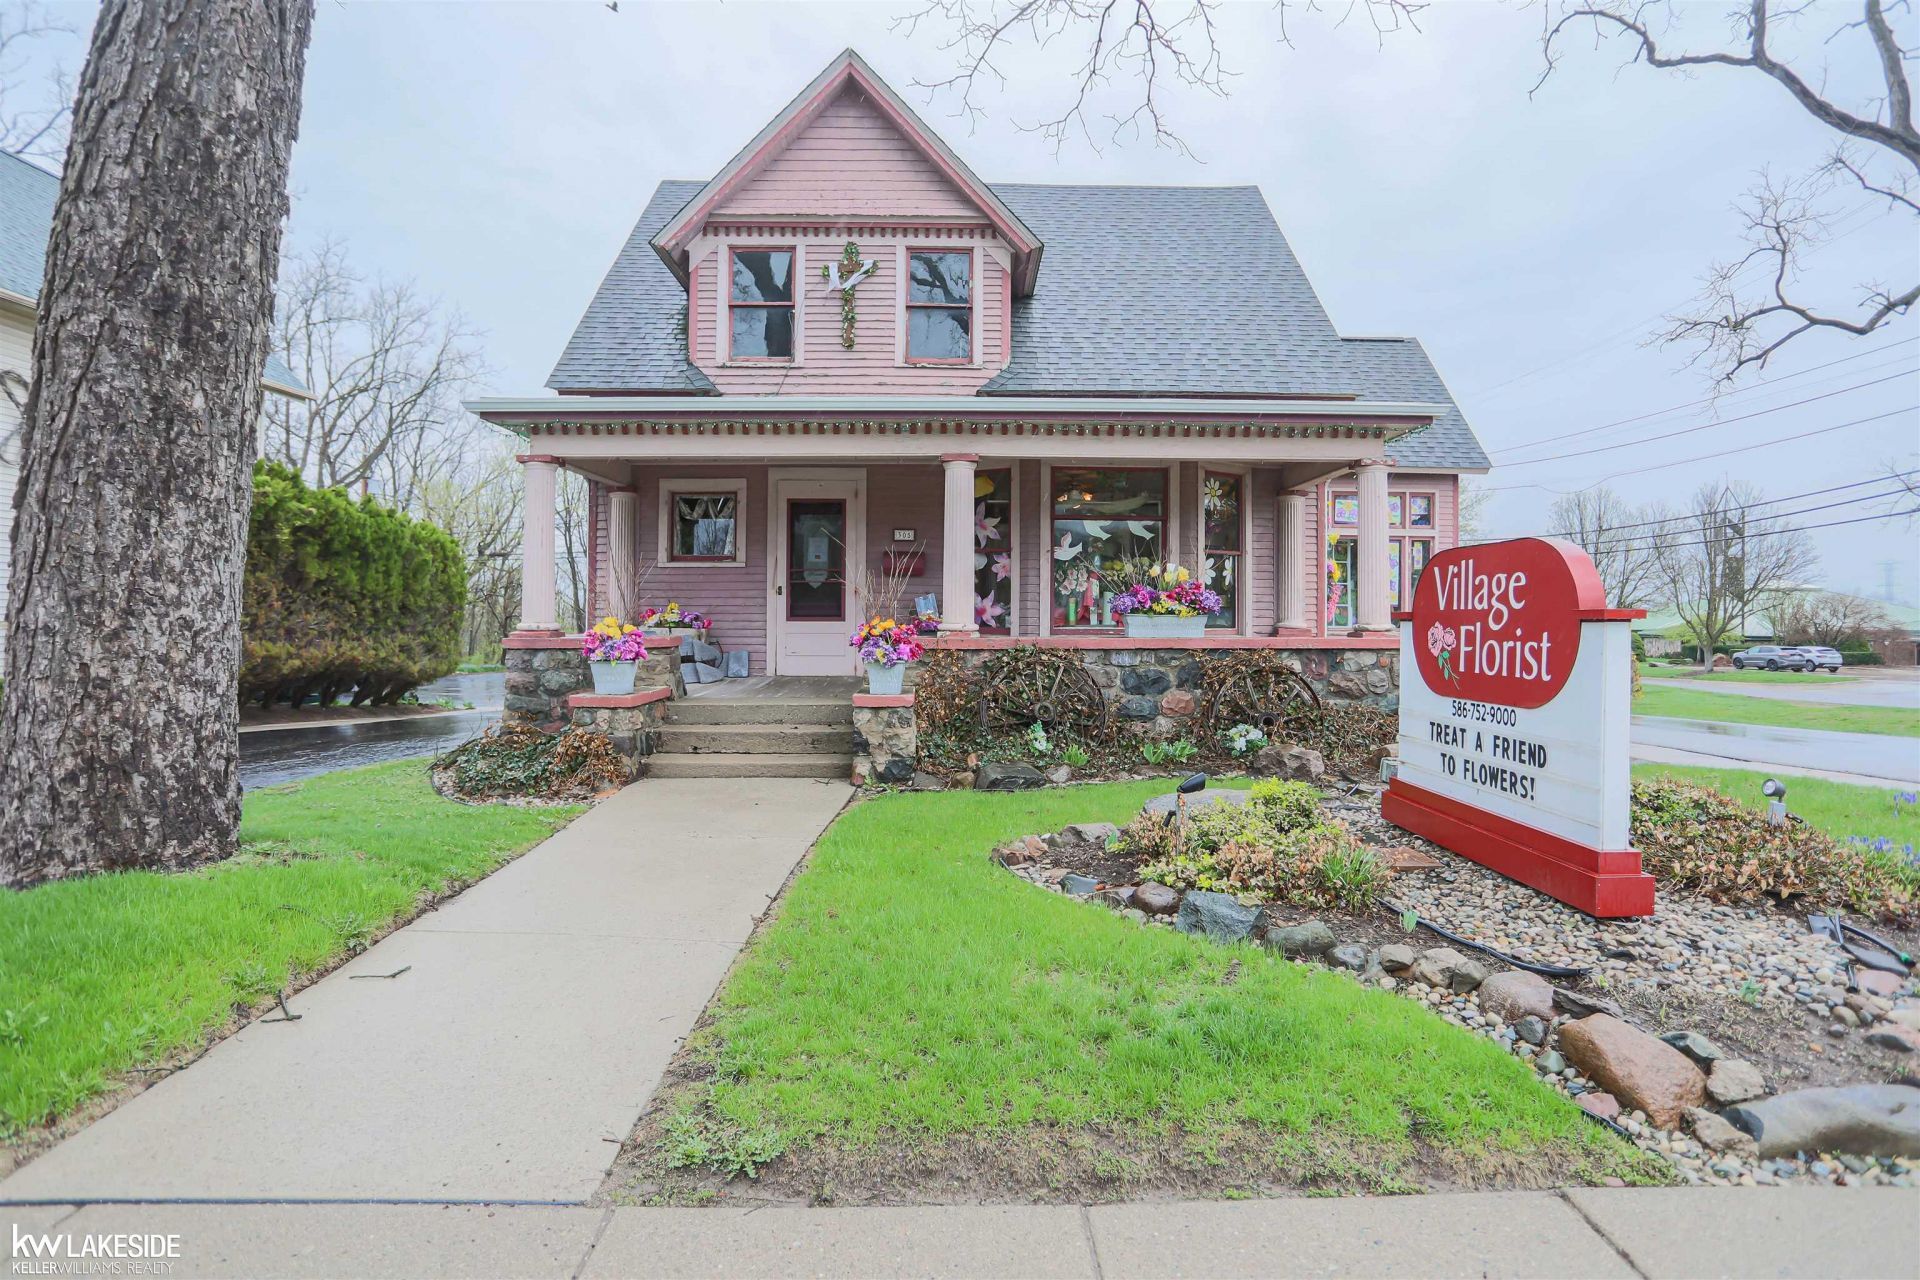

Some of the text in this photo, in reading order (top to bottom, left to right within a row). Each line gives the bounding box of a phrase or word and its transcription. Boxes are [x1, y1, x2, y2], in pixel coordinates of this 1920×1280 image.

[1434, 559, 1526, 630] Village
[1459, 622, 1551, 682] Florist
[1452, 700, 1517, 727] 586-752-9000
[1429, 721, 1547, 768] TREAT A FRIEND
[1441, 752, 1536, 801] TO FLOWERS!
